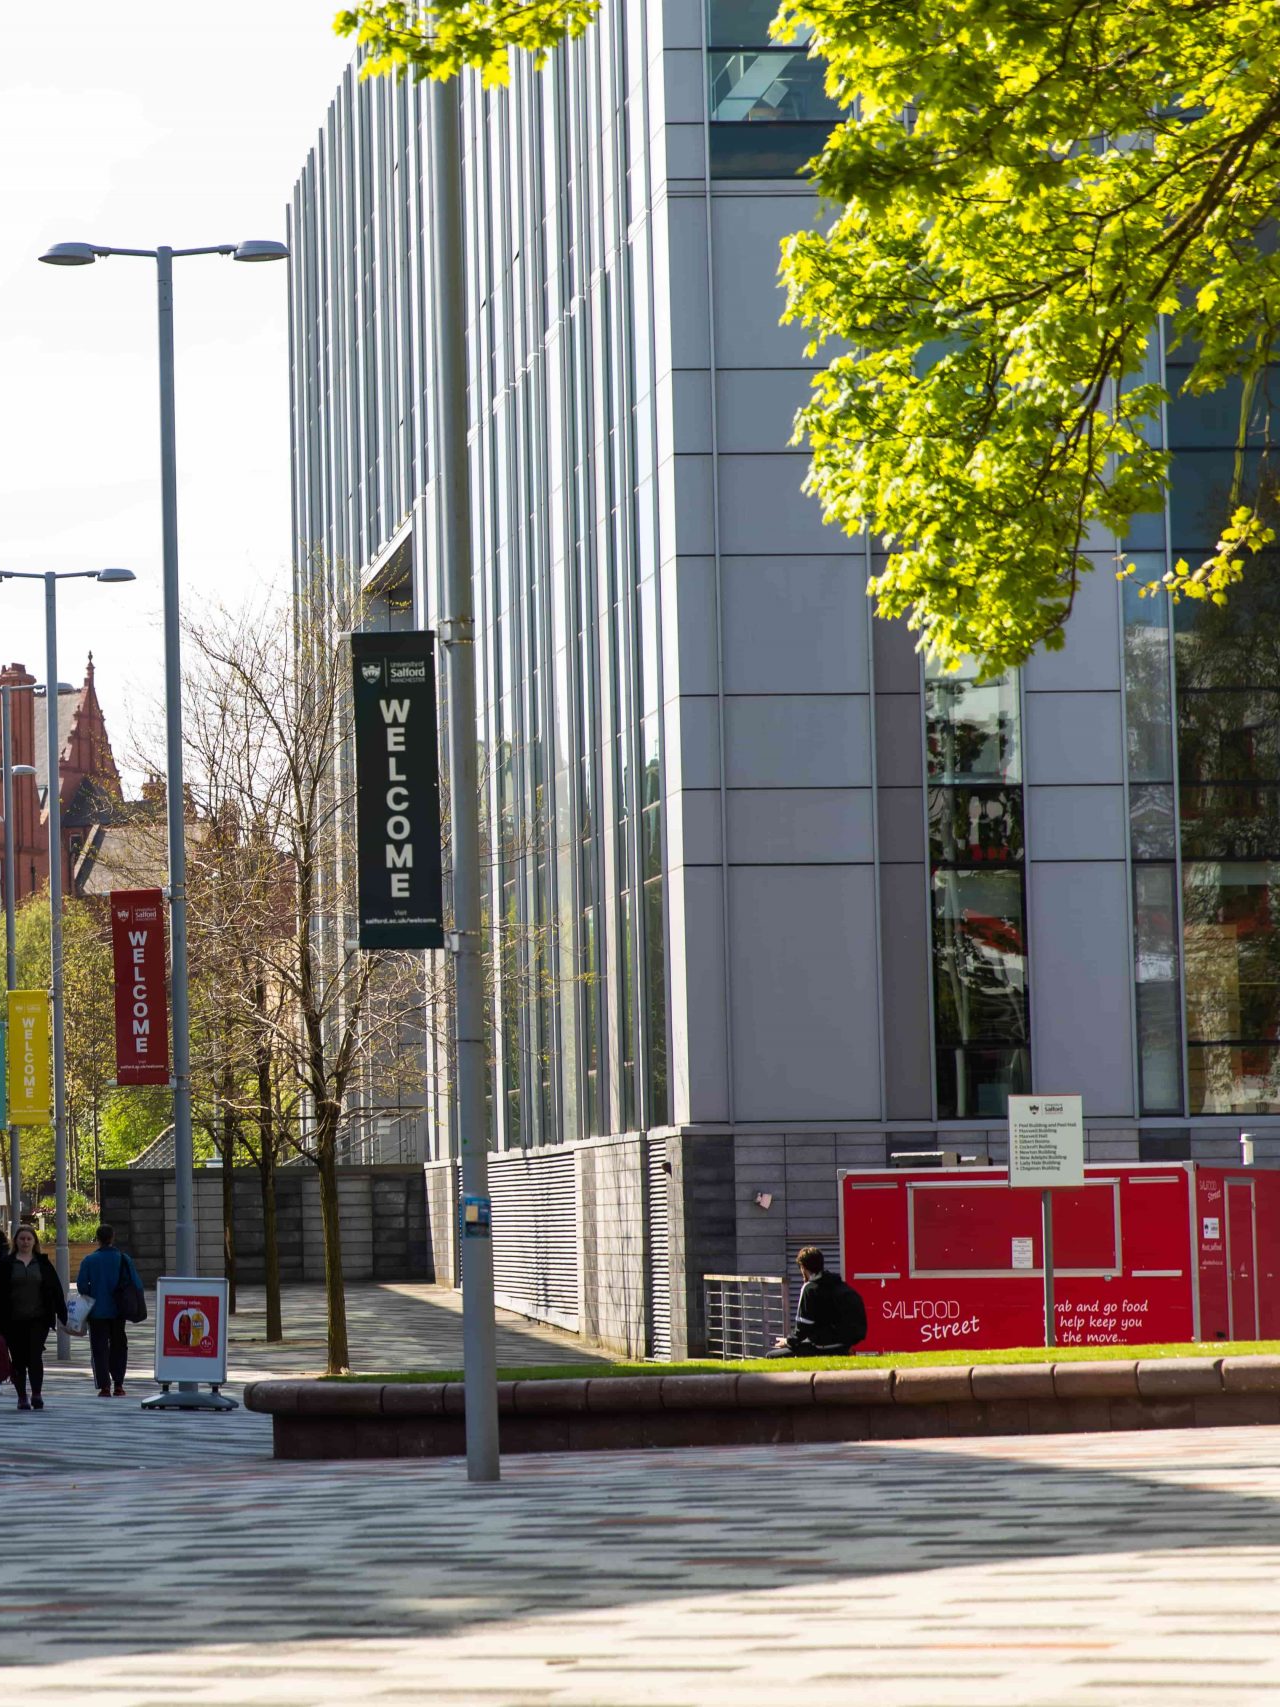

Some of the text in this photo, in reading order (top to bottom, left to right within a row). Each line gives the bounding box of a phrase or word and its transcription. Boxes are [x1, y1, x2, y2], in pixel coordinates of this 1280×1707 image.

[390, 667, 425, 677] Salford
[380, 699, 413, 898] WELCOME
[135, 910, 157, 918] Salford
[128, 931, 150, 1053] WELCOME
[22, 1018, 36, 1099] WELCOME
[882, 1301, 960, 1319] SALFOOD
[1076, 1299, 1099, 1312] and
[1103, 1303, 1118, 1316] go
[1122, 1299, 1148, 1312] food
[921, 1315, 980, 1343] Street
[1060, 1315, 1085, 1331] help
[1089, 1315, 1117, 1331] keep
[1121, 1318, 1143, 1331] you
[1063, 1330, 1081, 1343] the
[1087, 1333, 1127, 1343] move...
